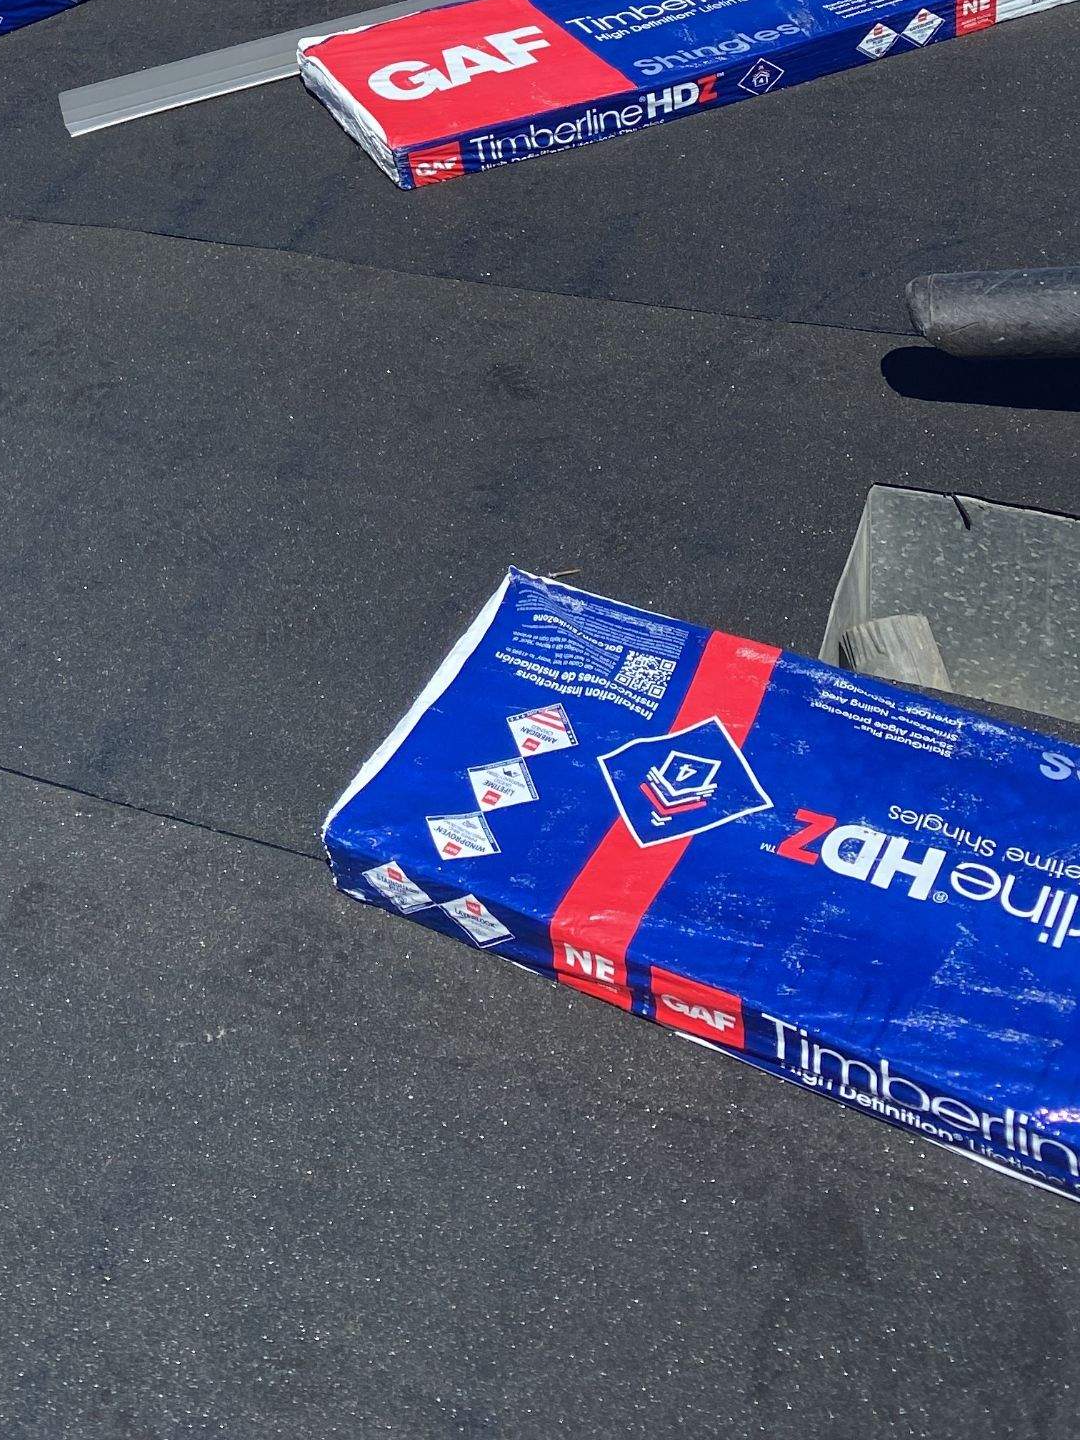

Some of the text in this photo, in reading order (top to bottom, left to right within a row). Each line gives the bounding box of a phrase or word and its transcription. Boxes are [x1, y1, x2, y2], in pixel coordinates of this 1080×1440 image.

[594, 26, 630, 42] High
[632, 22, 802, 77] Shingles
[367, 24, 552, 101] GAF
[414, 156, 459, 178] GAF
[561, 671, 577, 683] de
[584, 686, 654, 721] Installation
[821, 690, 848, 704] Area
[850, 699, 889, 717] Nailing
[521, 725, 559, 745] AMERICAN
[882, 723, 909, 739] Algae
[883, 730, 952, 758] StainGuard
[483, 779, 516, 797] LIFETIME
[887, 804, 998, 857] Shingles
[563, 942, 615, 984] NE
[661, 993, 736, 1033] GAF
